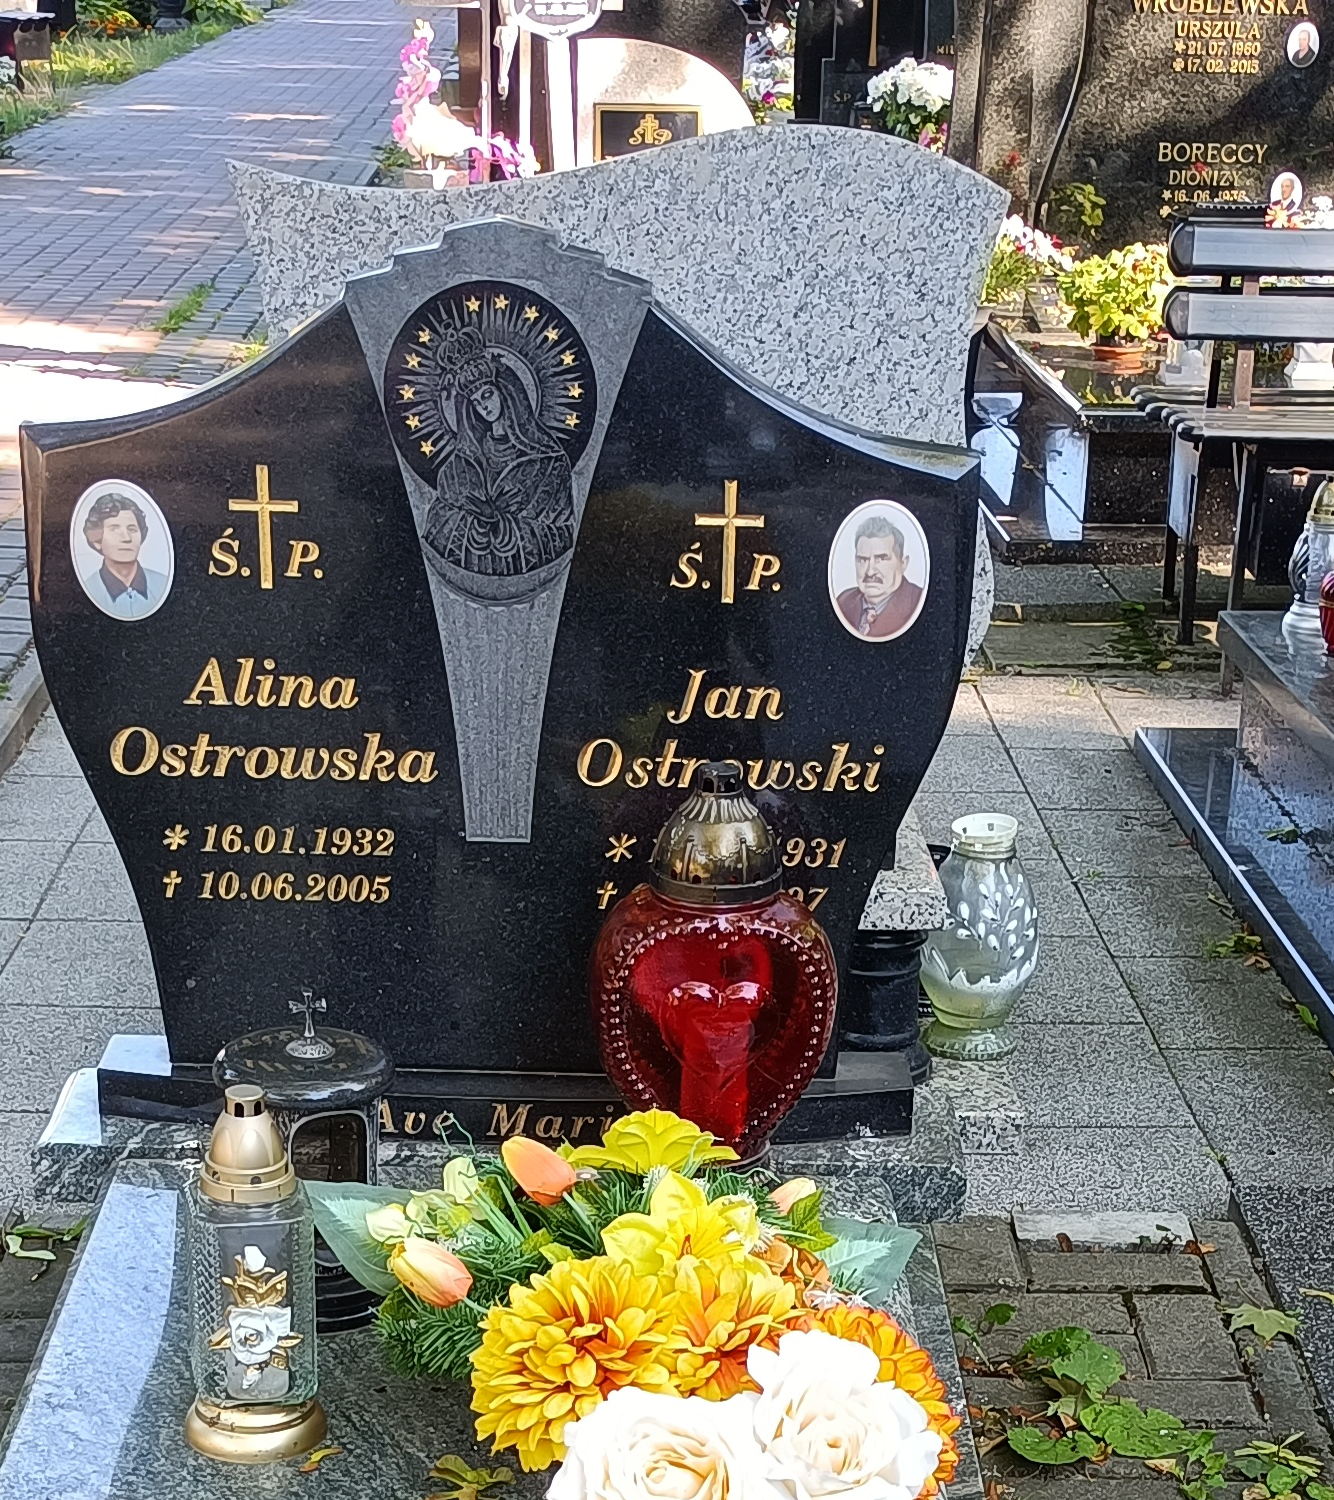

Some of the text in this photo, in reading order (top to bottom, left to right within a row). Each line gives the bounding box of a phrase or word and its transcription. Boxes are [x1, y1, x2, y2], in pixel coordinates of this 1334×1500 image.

[1176, 20, 1262, 39] URSZULA
[1157, 142, 1268, 164] BORECCY
[1168, 169, 1243, 187] DIONIZY
[208, 528, 324, 579] Ś. P.
[670, 542, 782, 592] Ś. P.
[183, 656, 359, 709] Alina
[667, 668, 784, 725] Jan
[109, 726, 439, 783] Ostrowska
[576, 738, 886, 793] Ostrwski
[199, 824, 396, 857] 16.01.1932
[197, 870, 392, 904] 10.06.2005
[378, 1098, 617, 1140] Ave Mari
